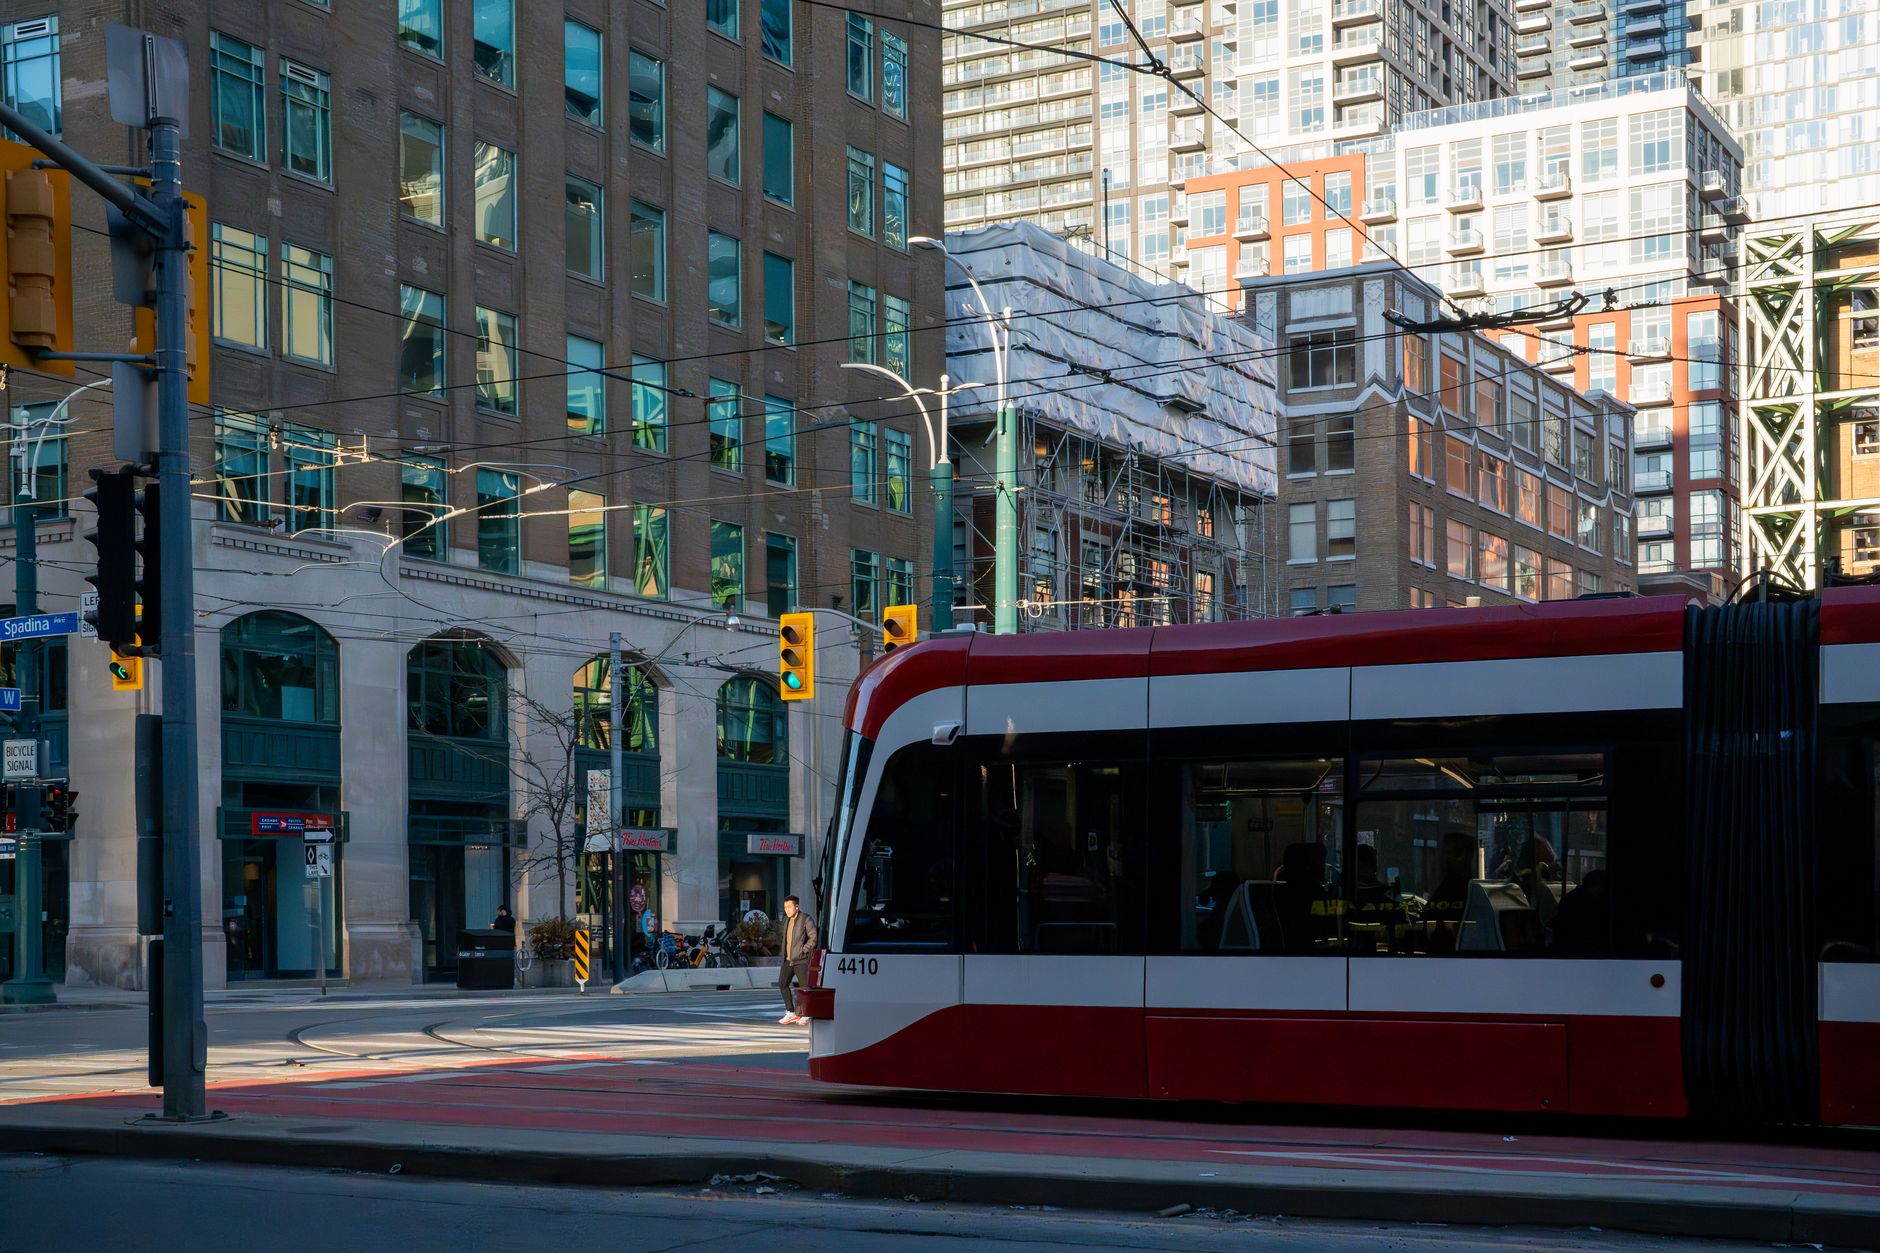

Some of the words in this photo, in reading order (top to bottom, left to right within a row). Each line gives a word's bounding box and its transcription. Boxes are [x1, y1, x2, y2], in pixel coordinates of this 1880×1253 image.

[85, 596, 99, 606] LEF
[4, 618, 50, 638] Spadina
[83, 623, 96, 633] SIG
[4, 690, 15, 705] W
[6, 745, 35, 757] BICYCLE
[7, 760, 34, 772] SIGNAL
[837, 957, 879, 976] 4410
